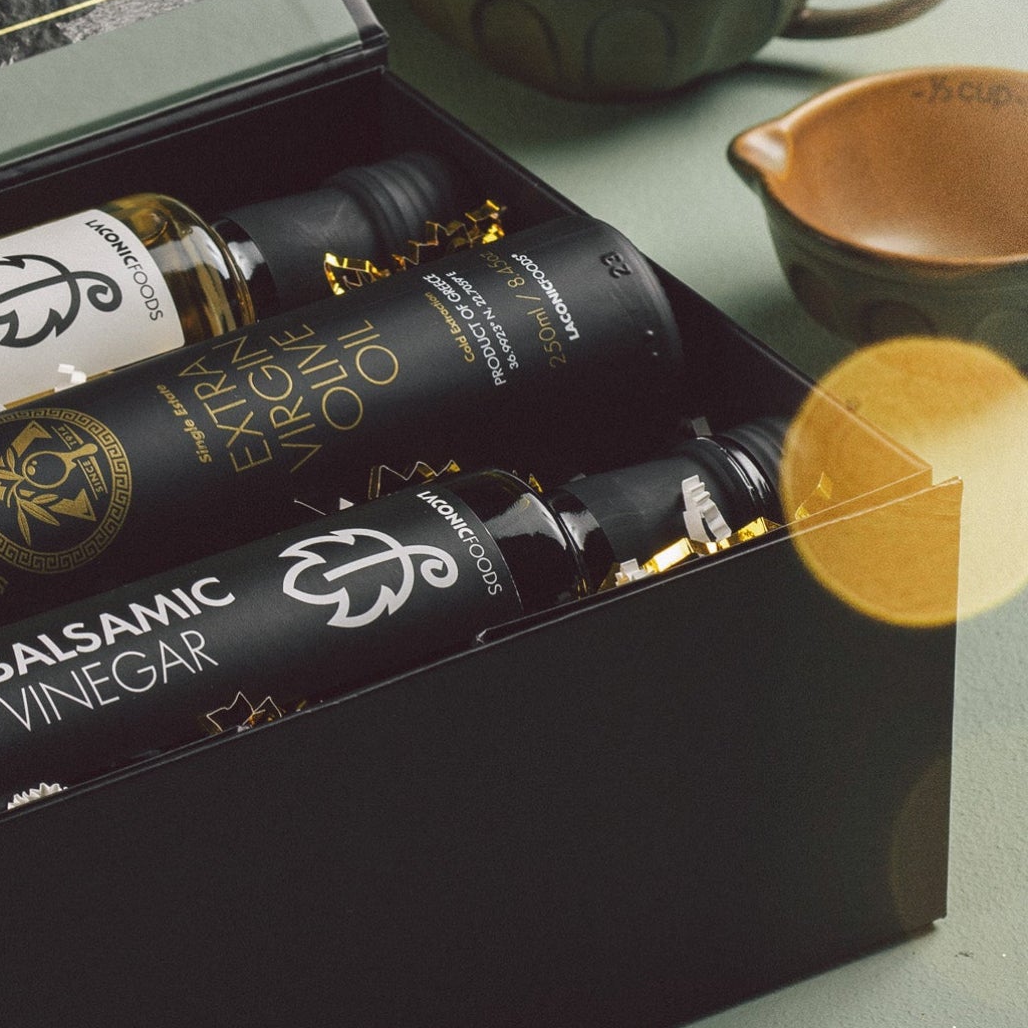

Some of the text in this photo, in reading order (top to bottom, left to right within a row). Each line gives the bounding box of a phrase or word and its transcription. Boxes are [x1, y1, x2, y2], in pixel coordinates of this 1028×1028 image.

[84, 219, 163, 322] LACONICFOODS
[269, 324, 363, 430] OLIVE
[337, 320, 398, 385] OIL
[422, 273, 506, 386] PRODUCT OF GREECE
[425, 292, 474, 362] Cold Extraction
[526, 307, 566, 368] 250ml
[156, 384, 212, 464] Single Estate
[178, 356, 272, 472] EXTRA
[212, 335, 322, 472] VIRGIN
[83, 460, 104, 494] SINCE
[416, 491, 502, 596] LACONICFOODS
